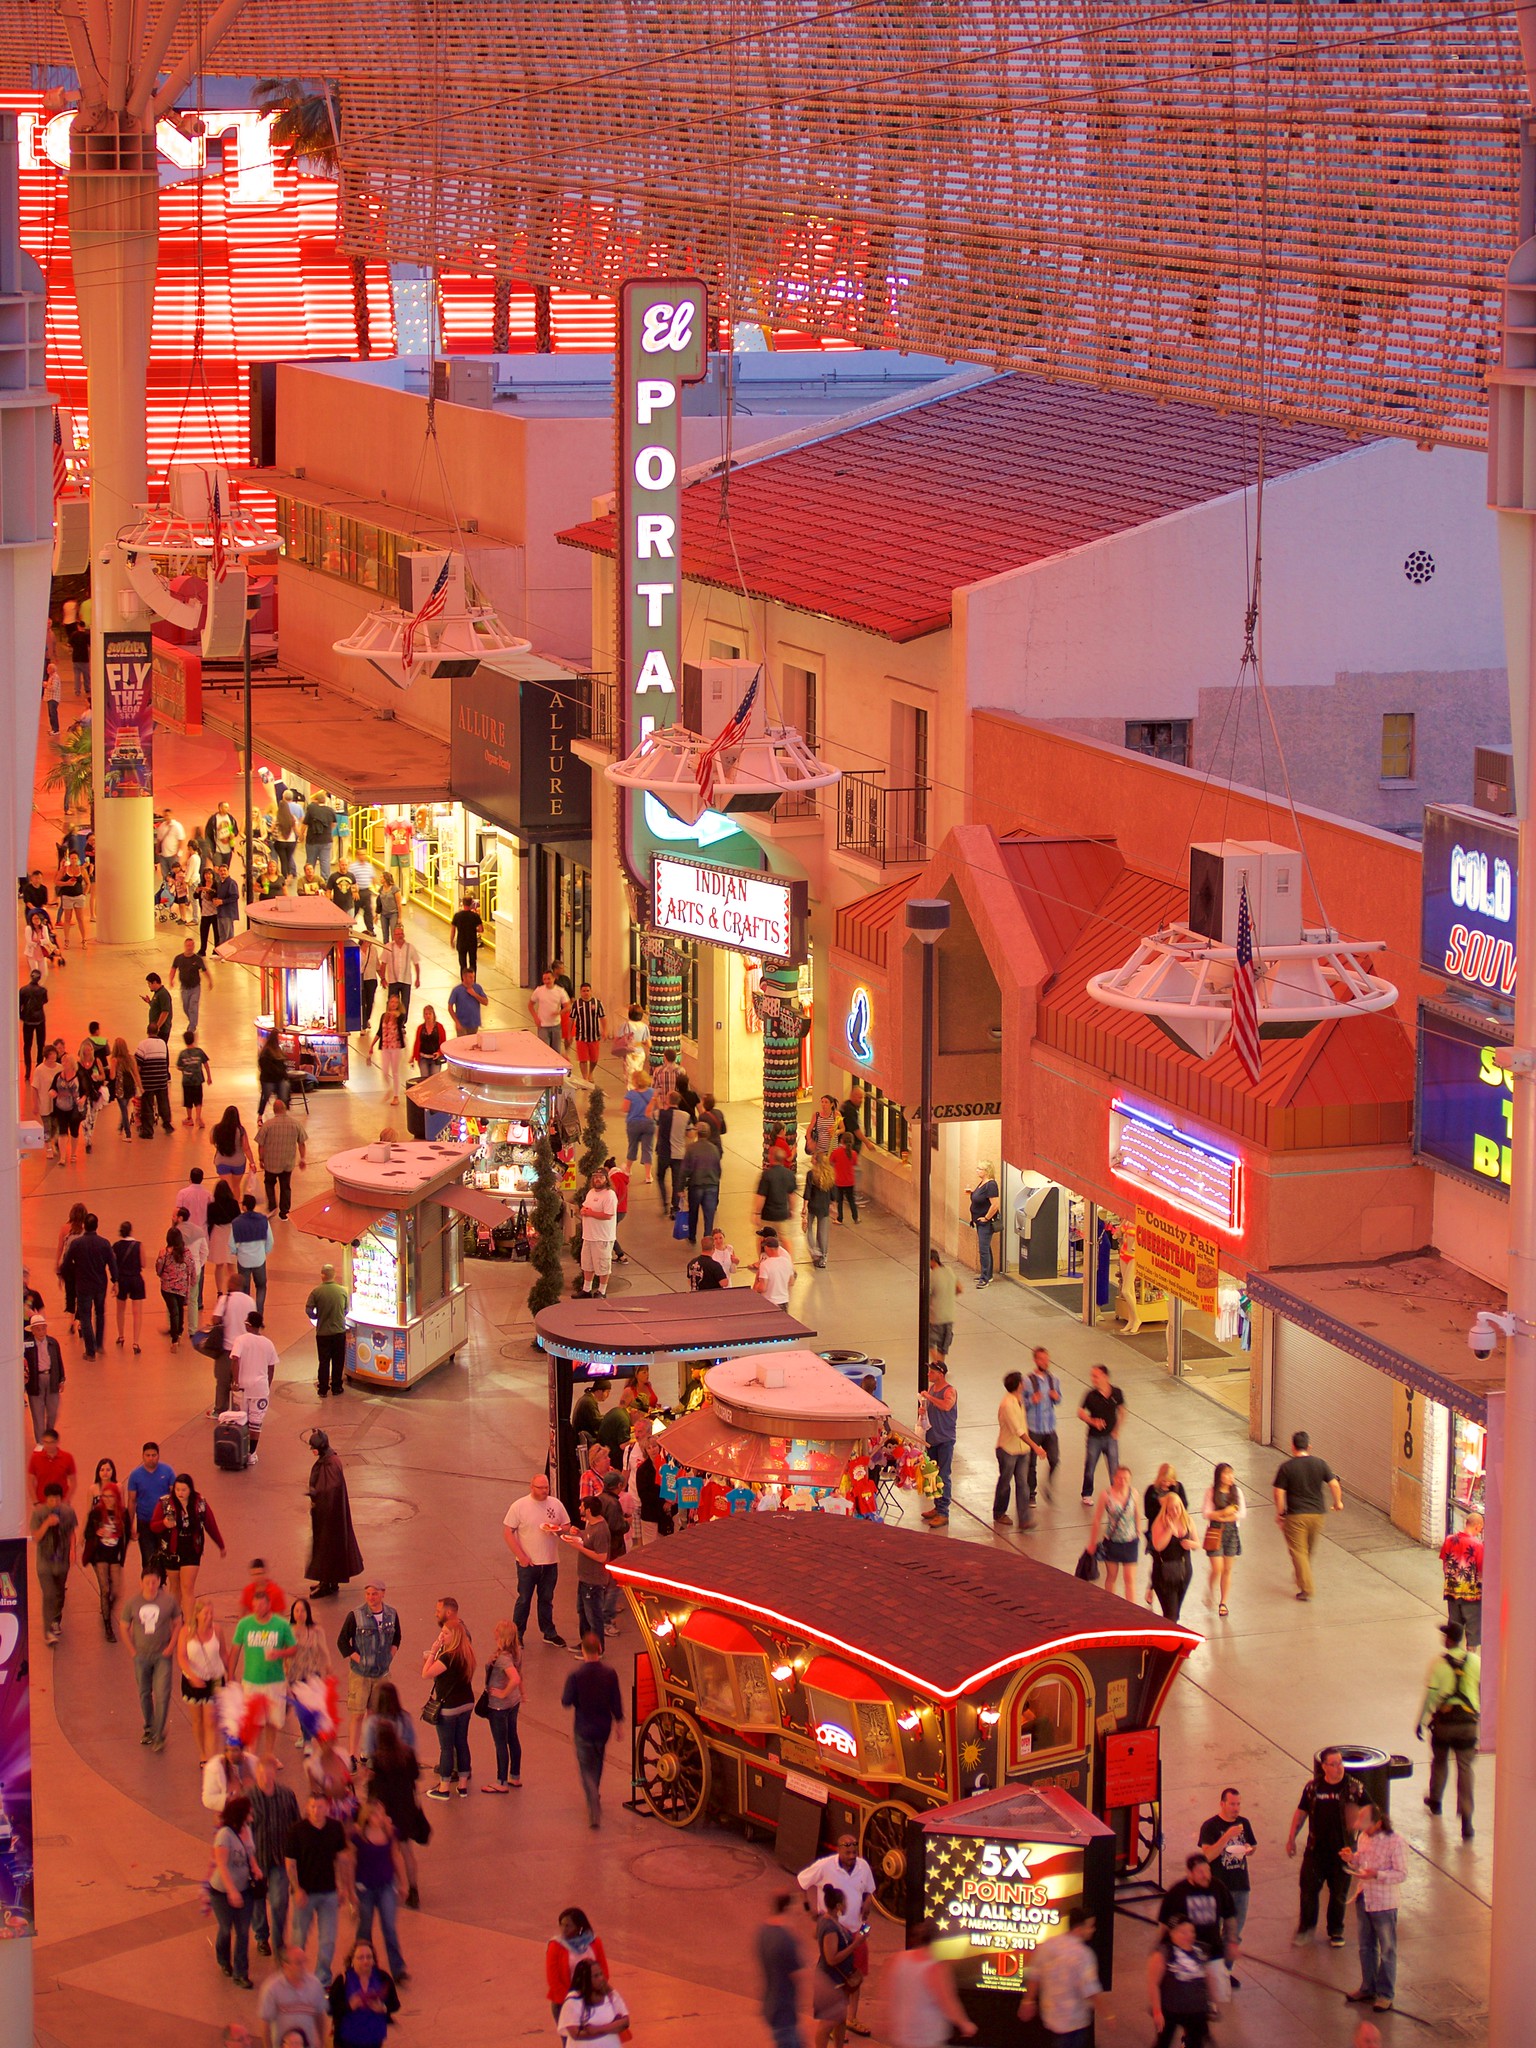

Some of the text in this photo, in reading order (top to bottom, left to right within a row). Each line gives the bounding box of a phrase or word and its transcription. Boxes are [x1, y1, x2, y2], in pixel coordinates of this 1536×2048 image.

[641, 300, 695, 353] El
[106, 662, 152, 690] FLY
[111, 690, 144, 706] THE
[116, 705, 140, 714] NEON
[458, 705, 505, 747] ALLURE
[549, 693, 564, 815] ALLURE
[696, 869, 747, 906] INDIAN
[1450, 845, 1511, 922] COLD
[664, 897, 780, 945] ARTS & CRAFTS
[911, 1102, 1002, 1120] ACESSORI
[1136, 1224, 1196, 1275] CHEESESTEAKS
[1146, 1210, 1187, 1244] County
[1189, 1231, 1216, 1257] Fair
[816, 1725, 858, 1757] OPEN
[980, 1845, 1031, 1878] 5X
[962, 1880, 1048, 1906] POINTS
[949, 1902, 1060, 1925] ON ALL SLOTS
[968, 1918, 1040, 1934] MEMORIAL DAY
[971, 1933, 1036, 1950] MAY 25, 2015
[982, 1953, 1018, 1976] the D
